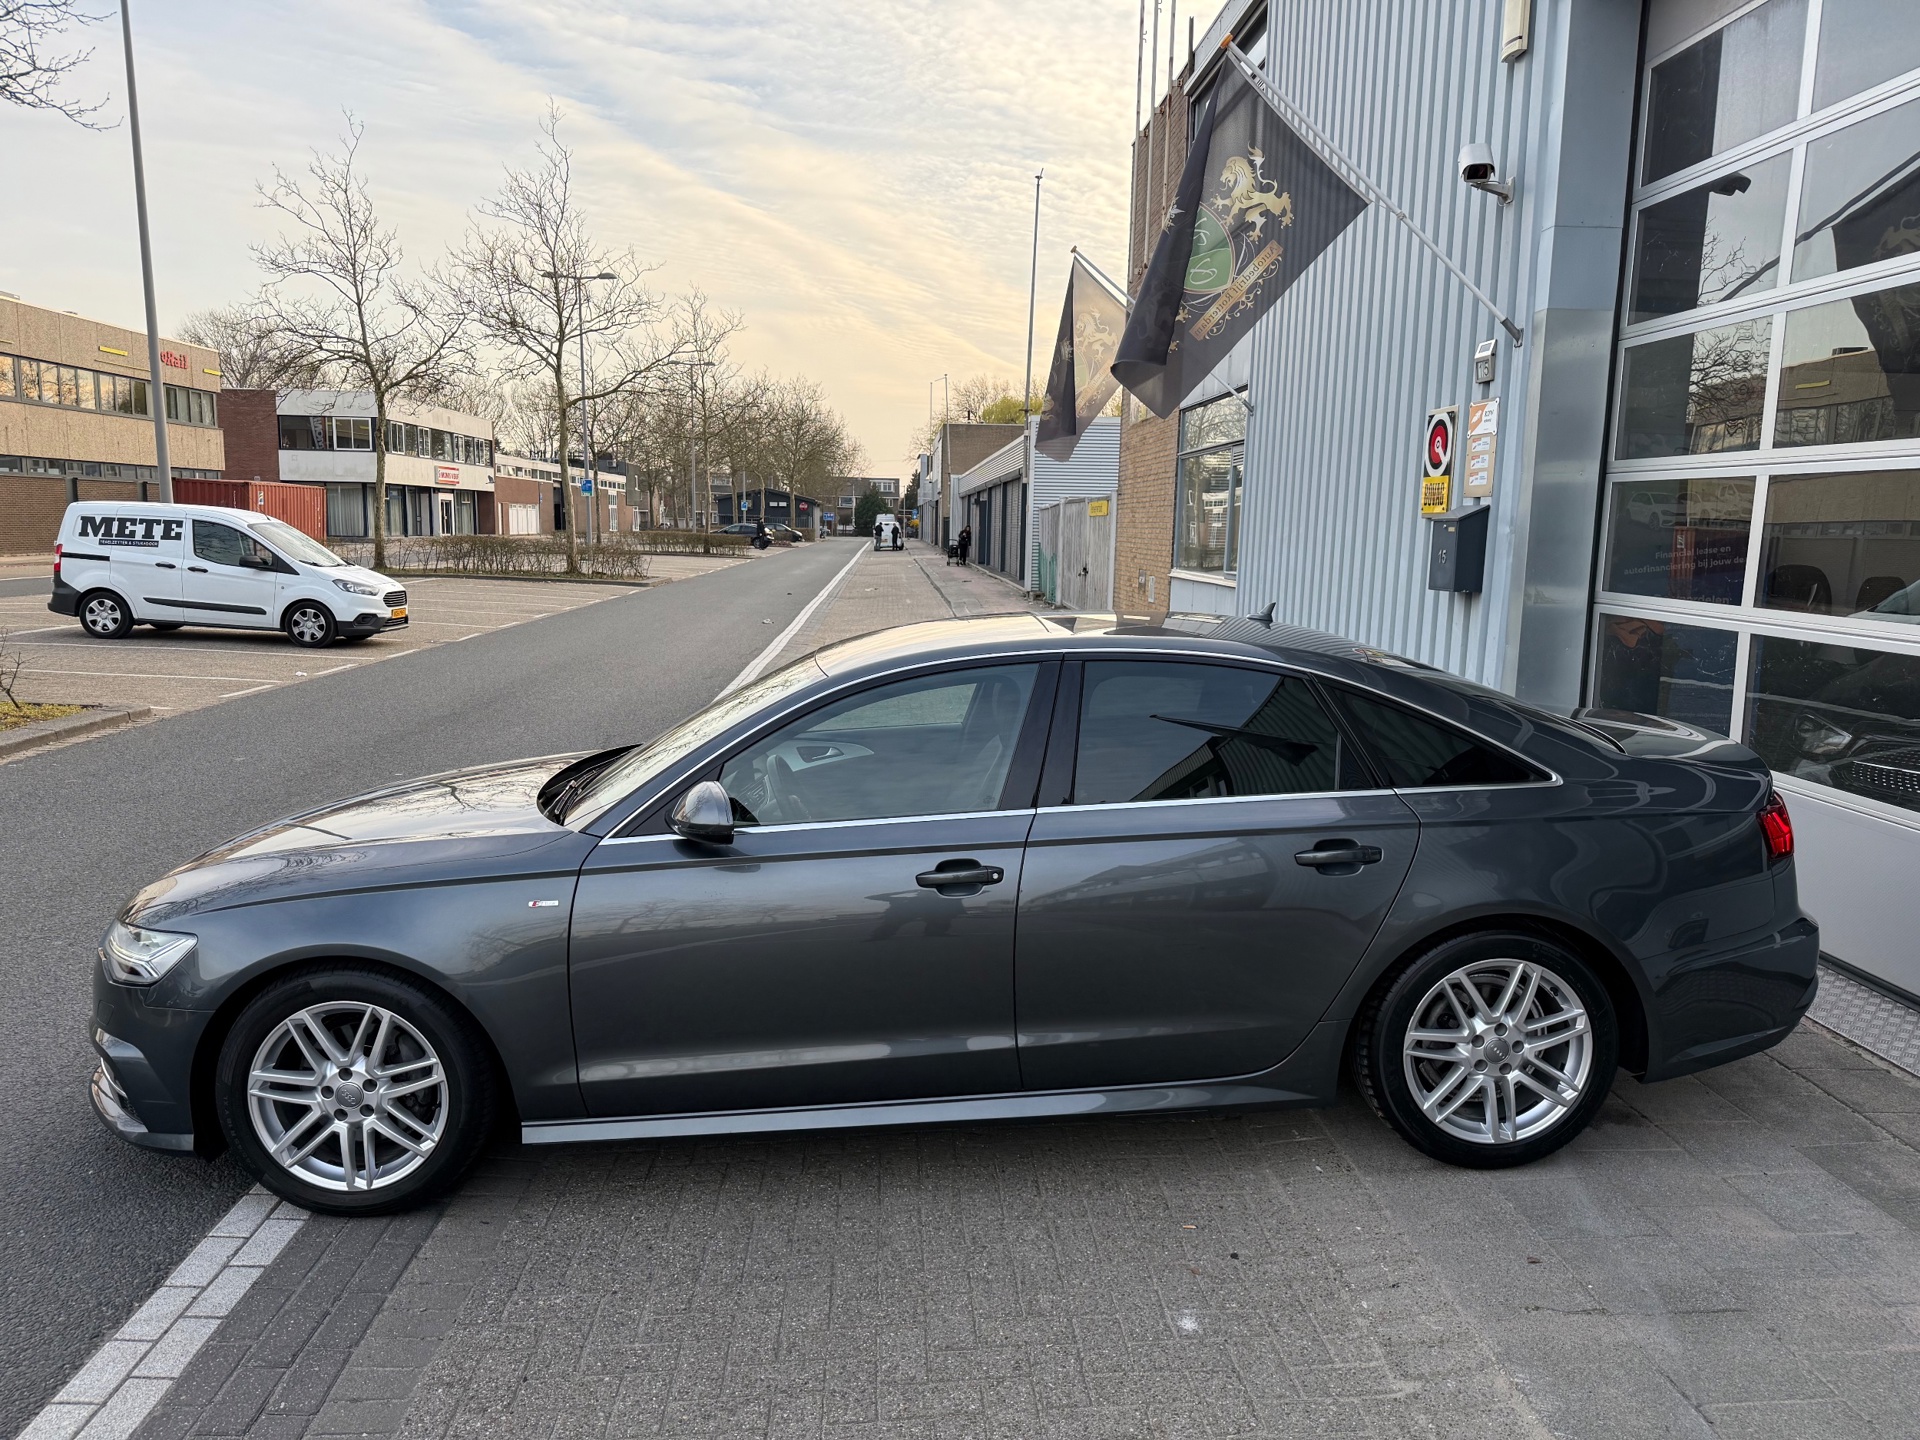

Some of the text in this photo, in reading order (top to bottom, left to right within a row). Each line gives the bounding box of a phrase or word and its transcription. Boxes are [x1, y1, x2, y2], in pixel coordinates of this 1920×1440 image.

[1476, 361, 1489, 378] 15
[78, 515, 184, 541] METE
[1437, 549, 1447, 564] 15
[1655, 548, 1694, 559] Financial
[1696, 547, 1718, 556] lease
[1624, 562, 1696, 575] autofinanciering
[1697, 559, 1708, 569] bij
[1709, 557, 1732, 568] jouw
